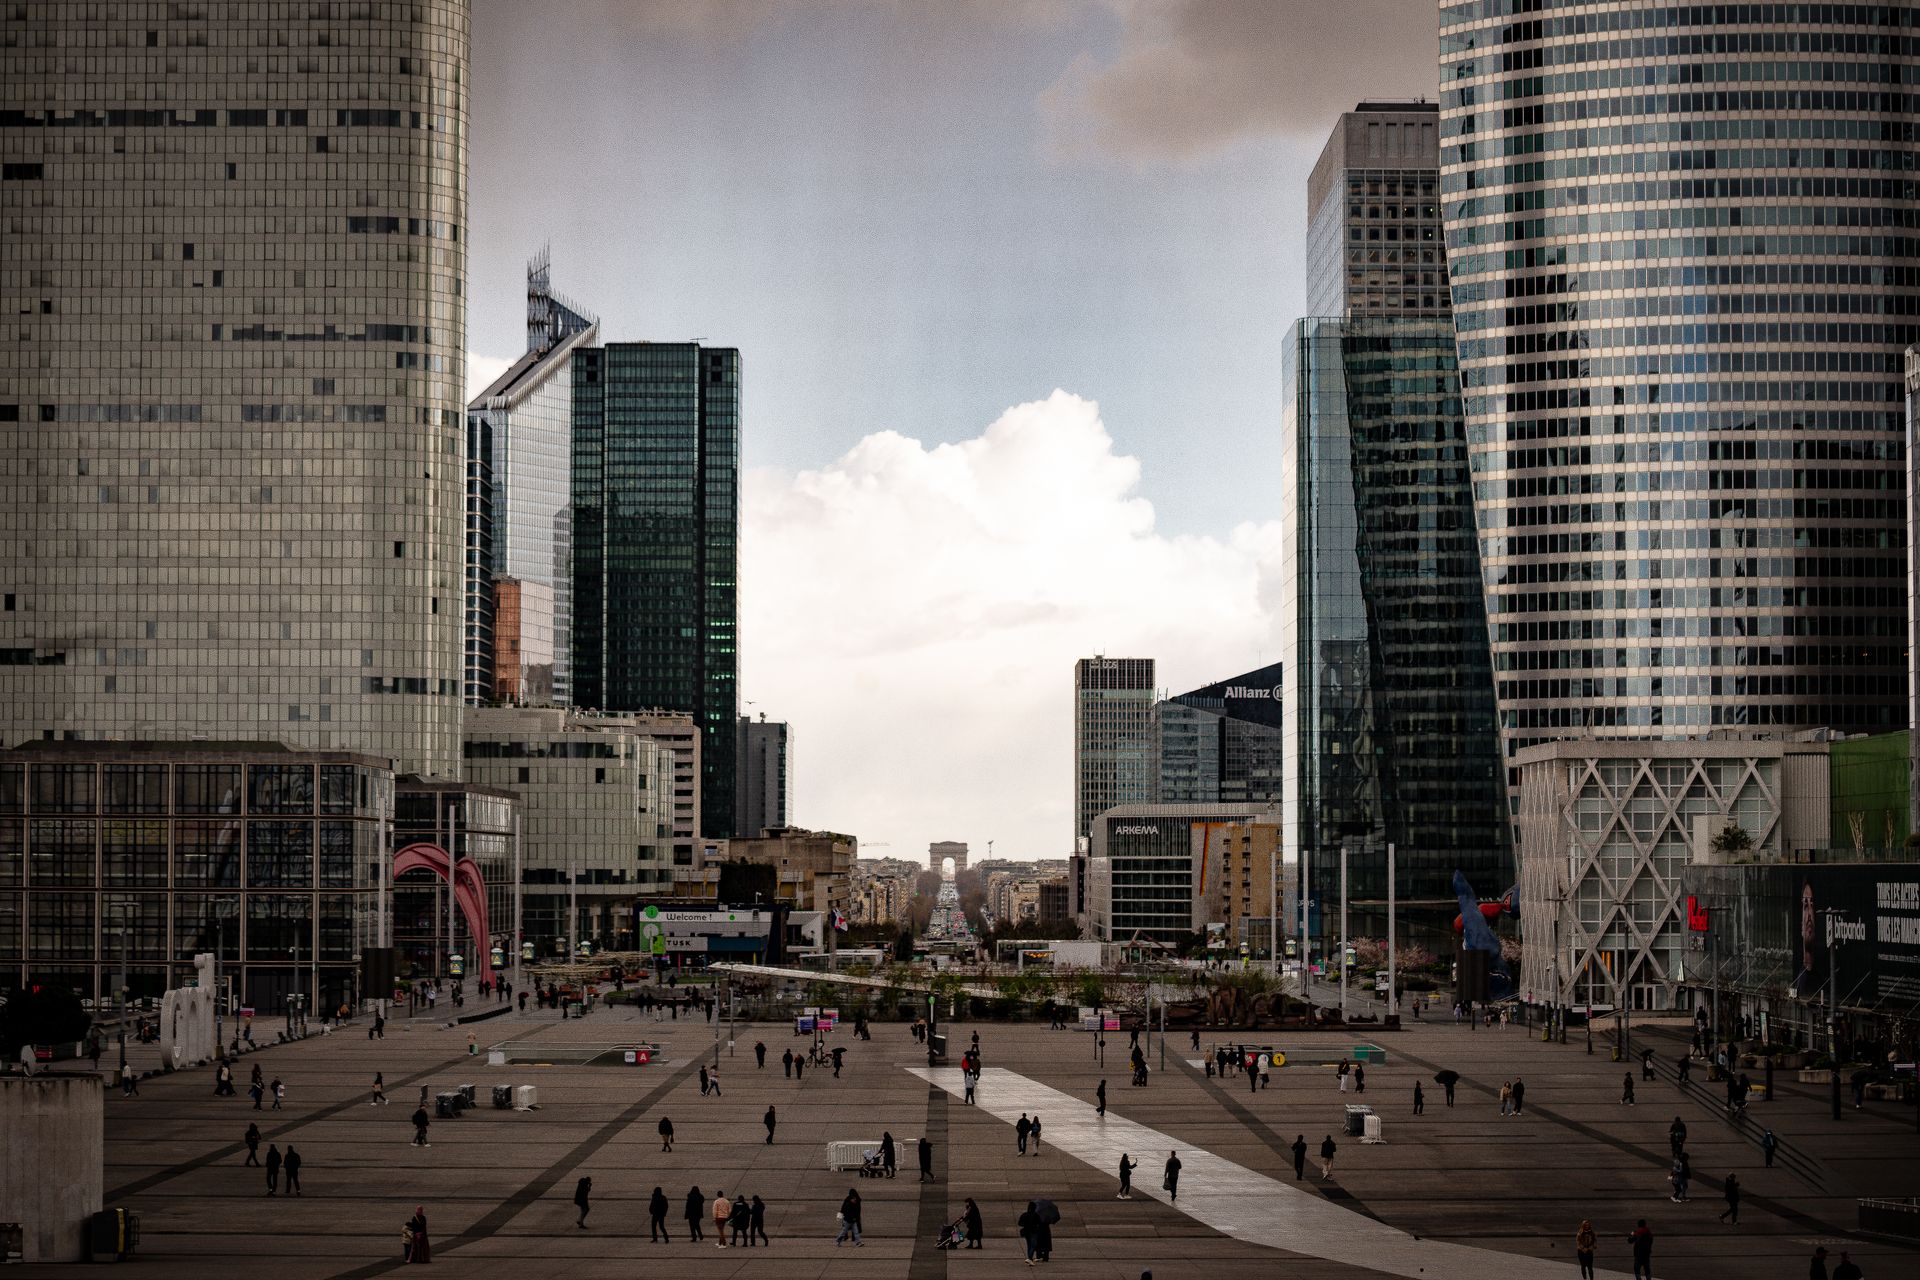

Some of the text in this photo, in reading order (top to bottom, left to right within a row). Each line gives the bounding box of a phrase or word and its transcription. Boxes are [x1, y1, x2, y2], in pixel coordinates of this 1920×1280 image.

[1224, 686, 1270, 698] Allianz
[1115, 825, 1158, 835] ARKEMA
[1876, 882, 1890, 909] TOUS
[1890, 882, 1900, 909] LES
[666, 913, 707, 921] Welcome
[1834, 915, 1866, 945] bitpanda
[1876, 916, 1890, 943] TOUS
[1891, 916, 1900, 944] LES
[639, 1053, 647, 1061] A
